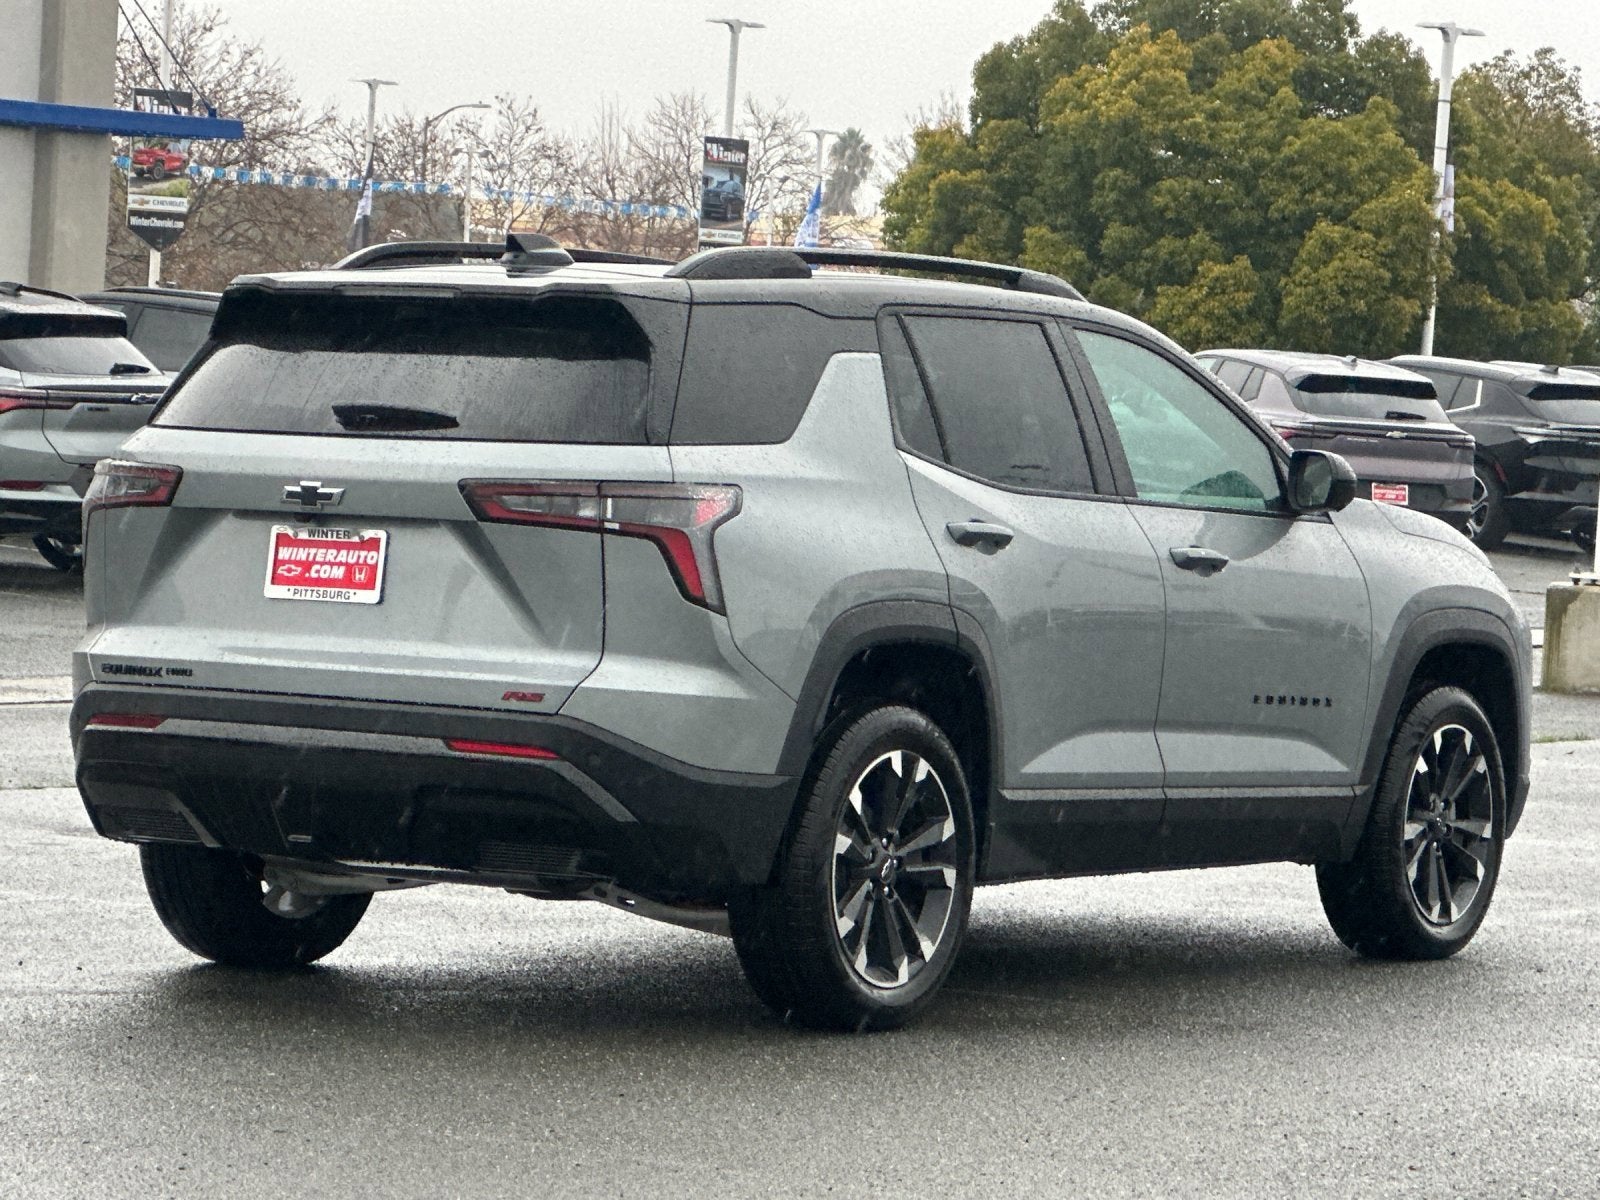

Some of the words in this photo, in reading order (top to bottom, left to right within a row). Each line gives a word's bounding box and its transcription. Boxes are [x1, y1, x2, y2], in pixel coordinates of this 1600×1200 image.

[706, 142, 746, 163] Winter
[152, 199, 185, 207] CHEVROLET
[129, 215, 185, 229] WinterChevrolet.com
[307, 528, 351, 540] WINTER
[277, 546, 378, 565] WINTERAUTO
[304, 564, 346, 579] .COM
[292, 588, 351, 600] PITTSBURG
[101, 663, 163, 677] EQUINOX
[501, 690, 546, 703] RS
[1253, 694, 1332, 707] EQUINOX
